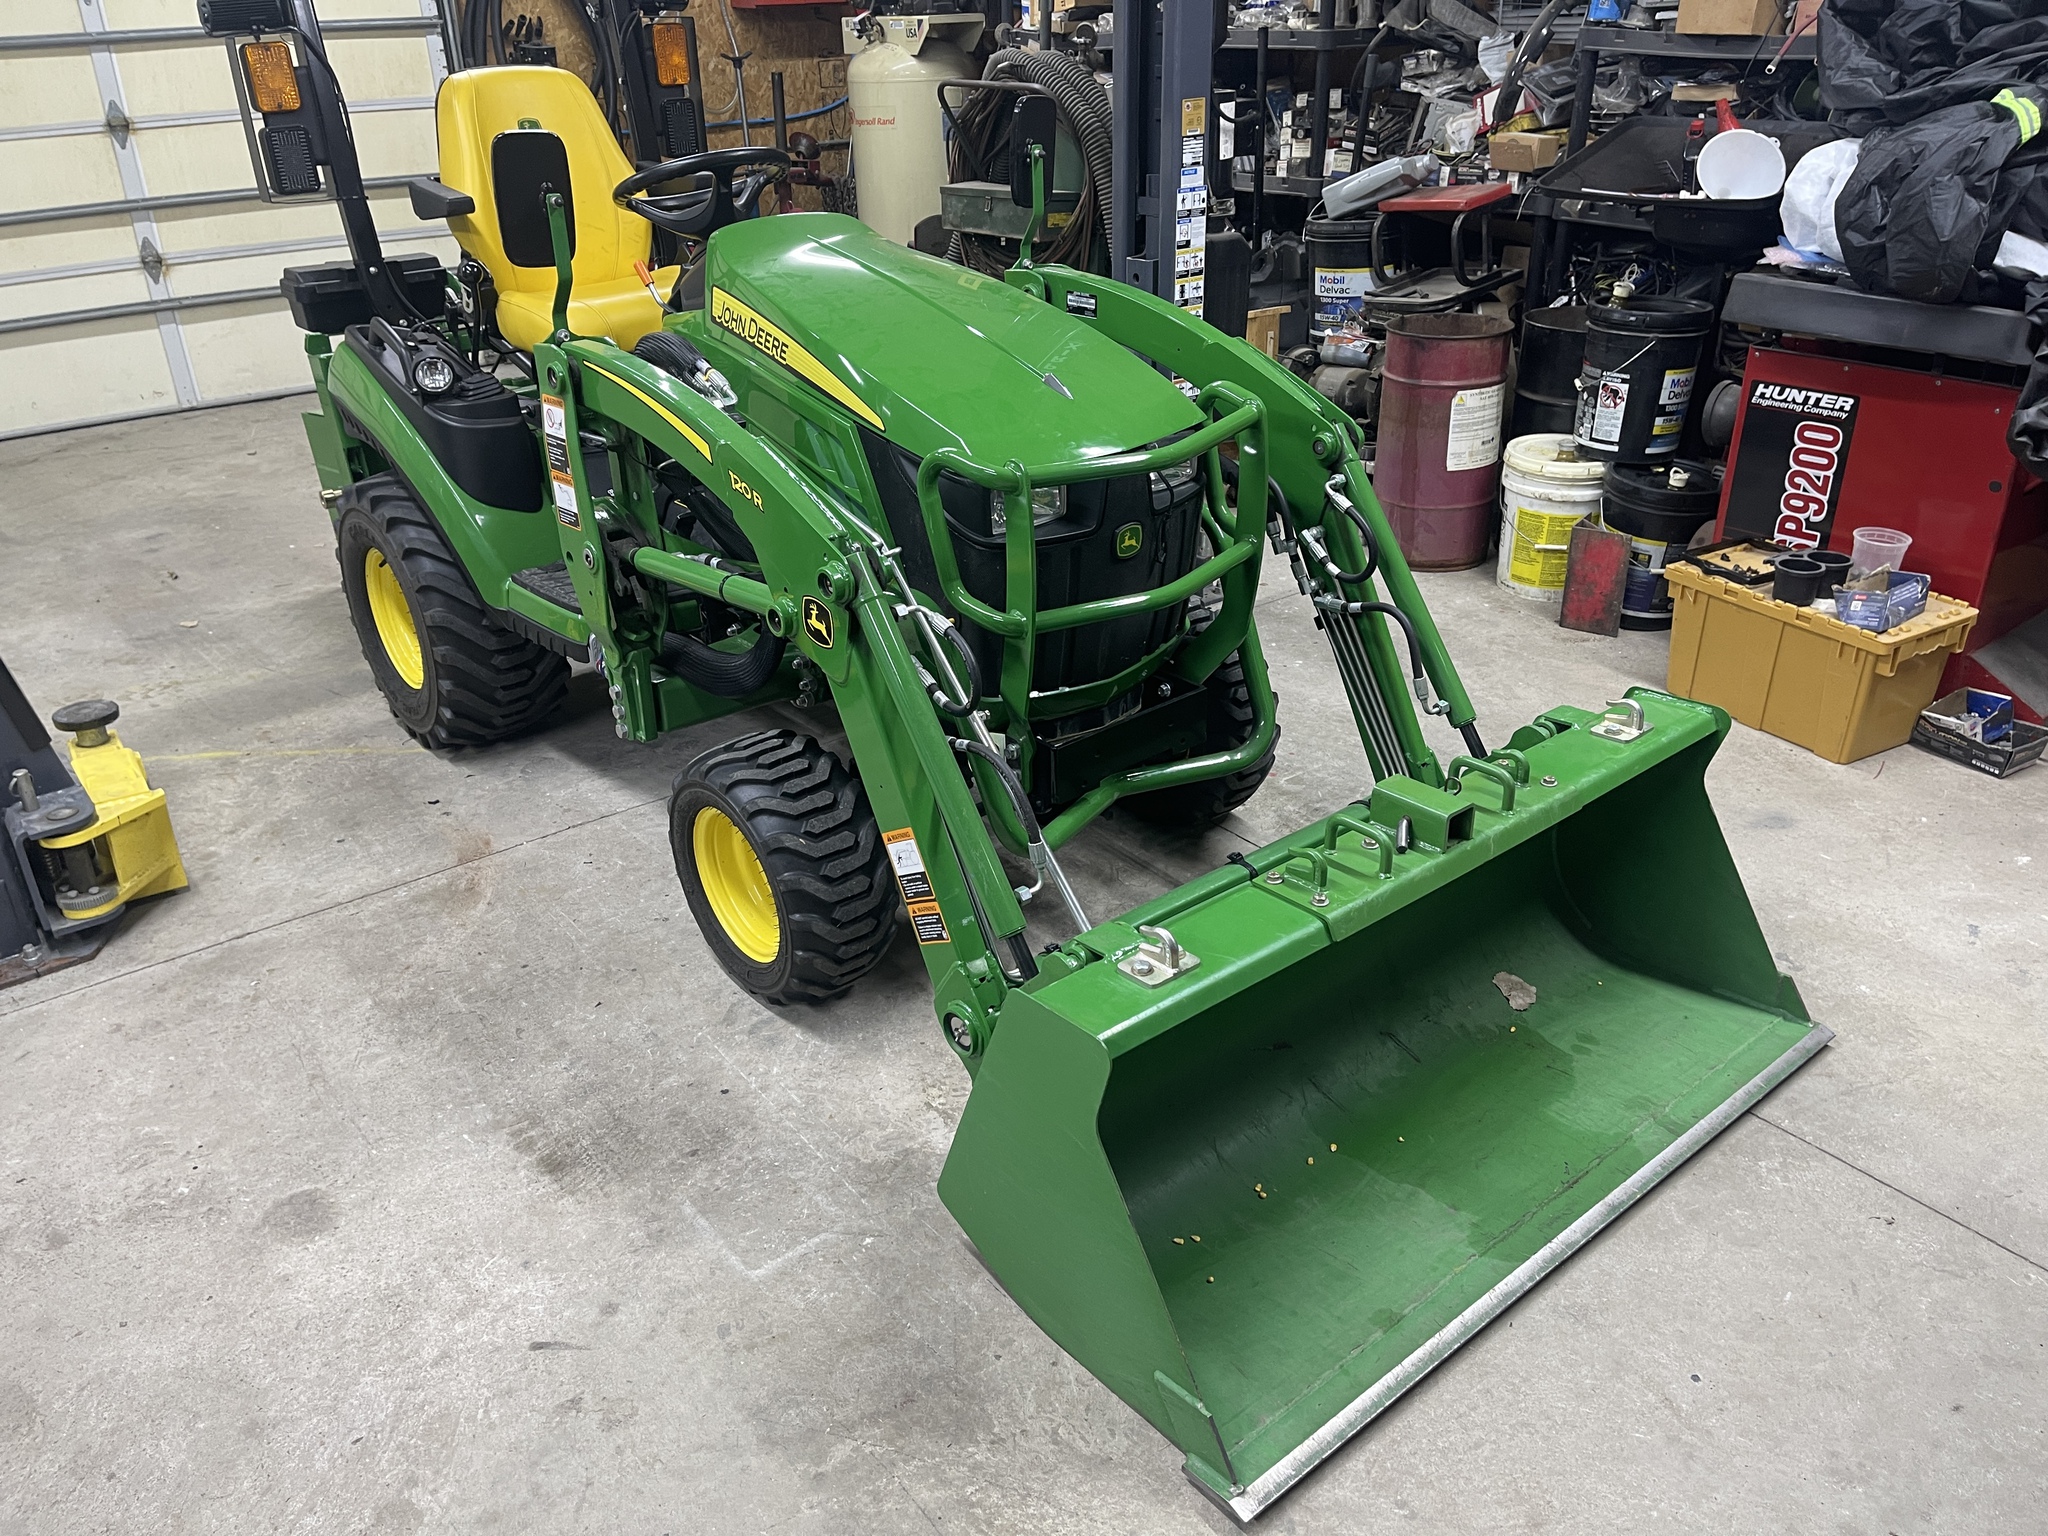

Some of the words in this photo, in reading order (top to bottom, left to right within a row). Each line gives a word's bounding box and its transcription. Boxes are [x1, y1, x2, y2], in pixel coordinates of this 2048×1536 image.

[905, 27, 917, 38] USA
[877, 116, 895, 125] Rand
[1320, 275, 1344, 284] Mobil
[1320, 285, 1350, 294] Delvac
[717, 301, 746, 335] JOHN
[748, 317, 789, 362] DEERE
[1754, 383, 1855, 412] HUNTER
[1751, 396, 1803, 412] Engineering
[1803, 404, 1849, 420] Company
[891, 831, 911, 841] WARNING
[917, 905, 937, 913] WARNING
